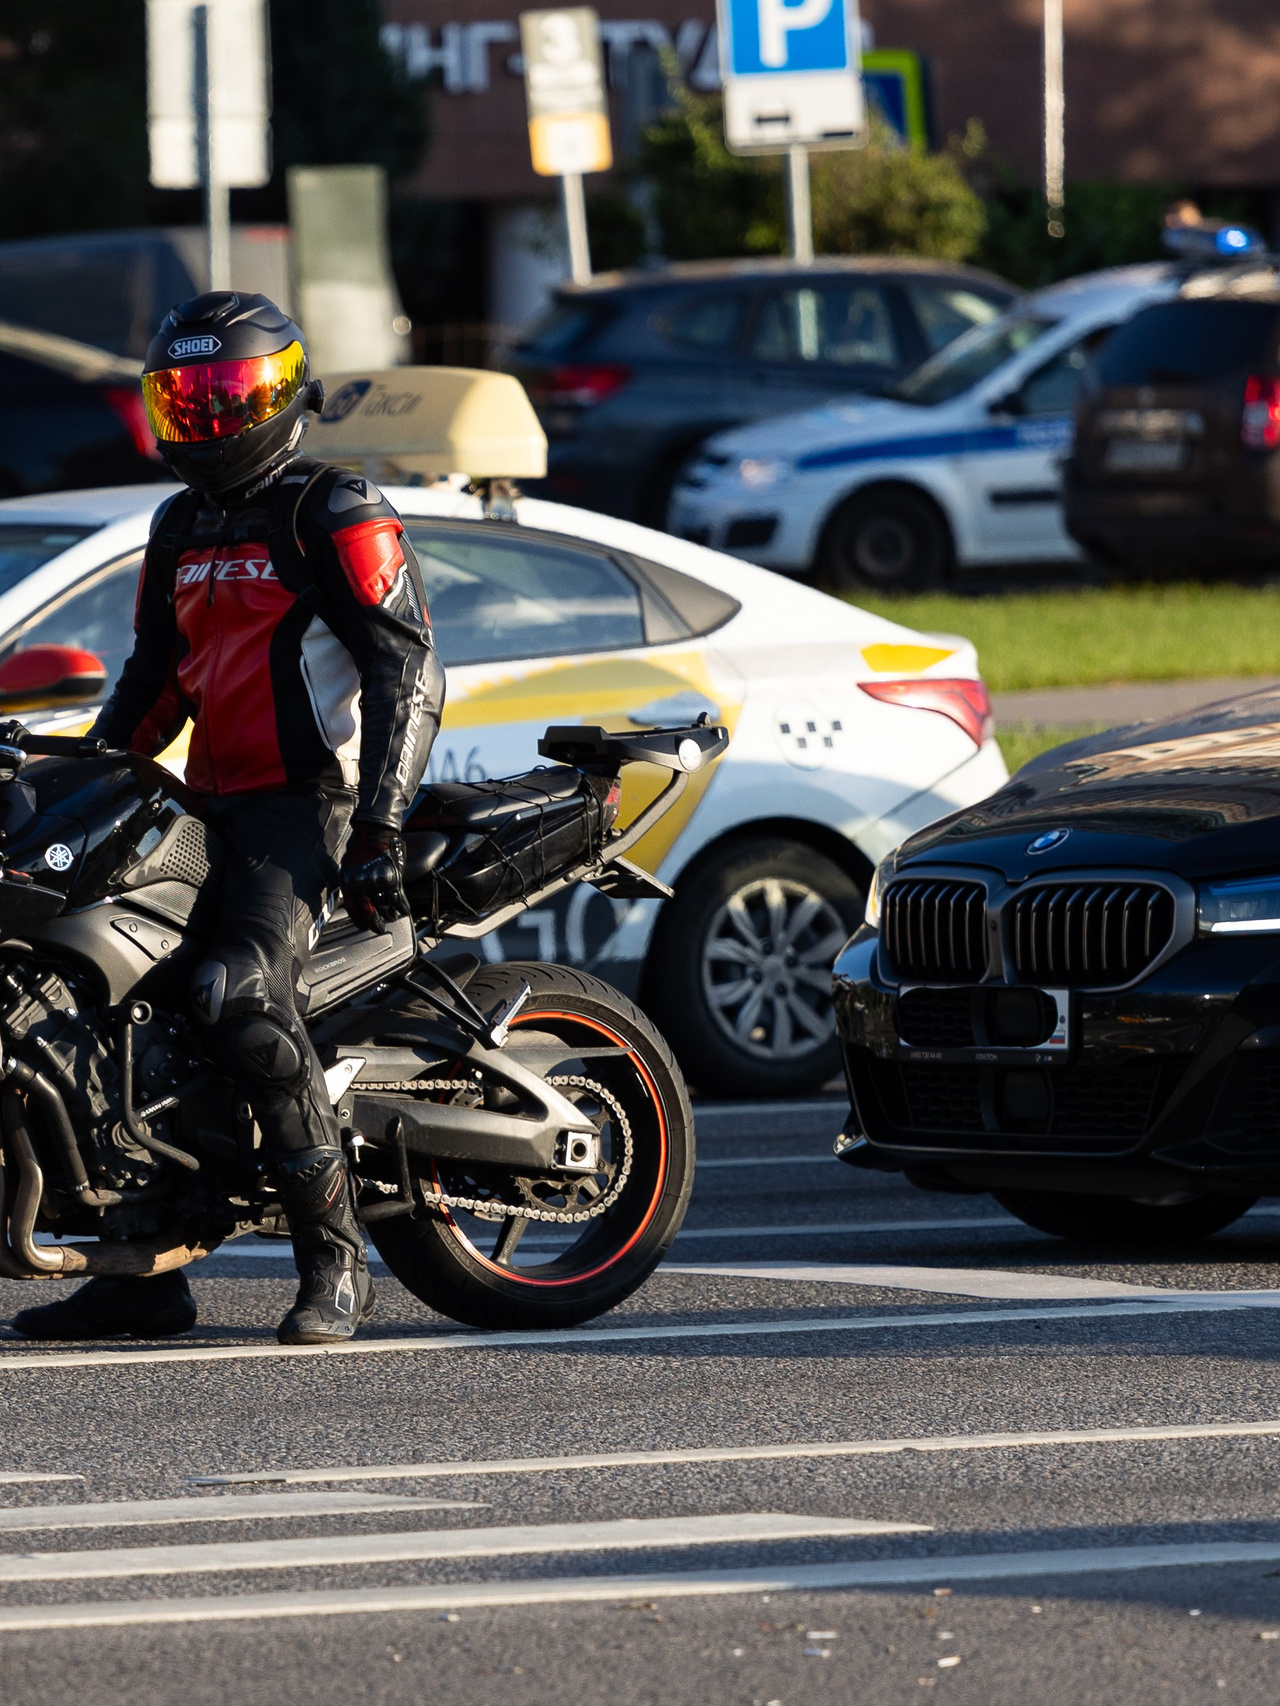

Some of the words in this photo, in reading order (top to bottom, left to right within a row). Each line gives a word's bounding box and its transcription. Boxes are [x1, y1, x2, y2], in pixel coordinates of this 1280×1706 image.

[758, 0, 828, 68] P
[173, 338, 214, 355] SHOEI
[395, 669, 429, 786] DAINESE
[536, 995, 597, 1011] MICHELIN
